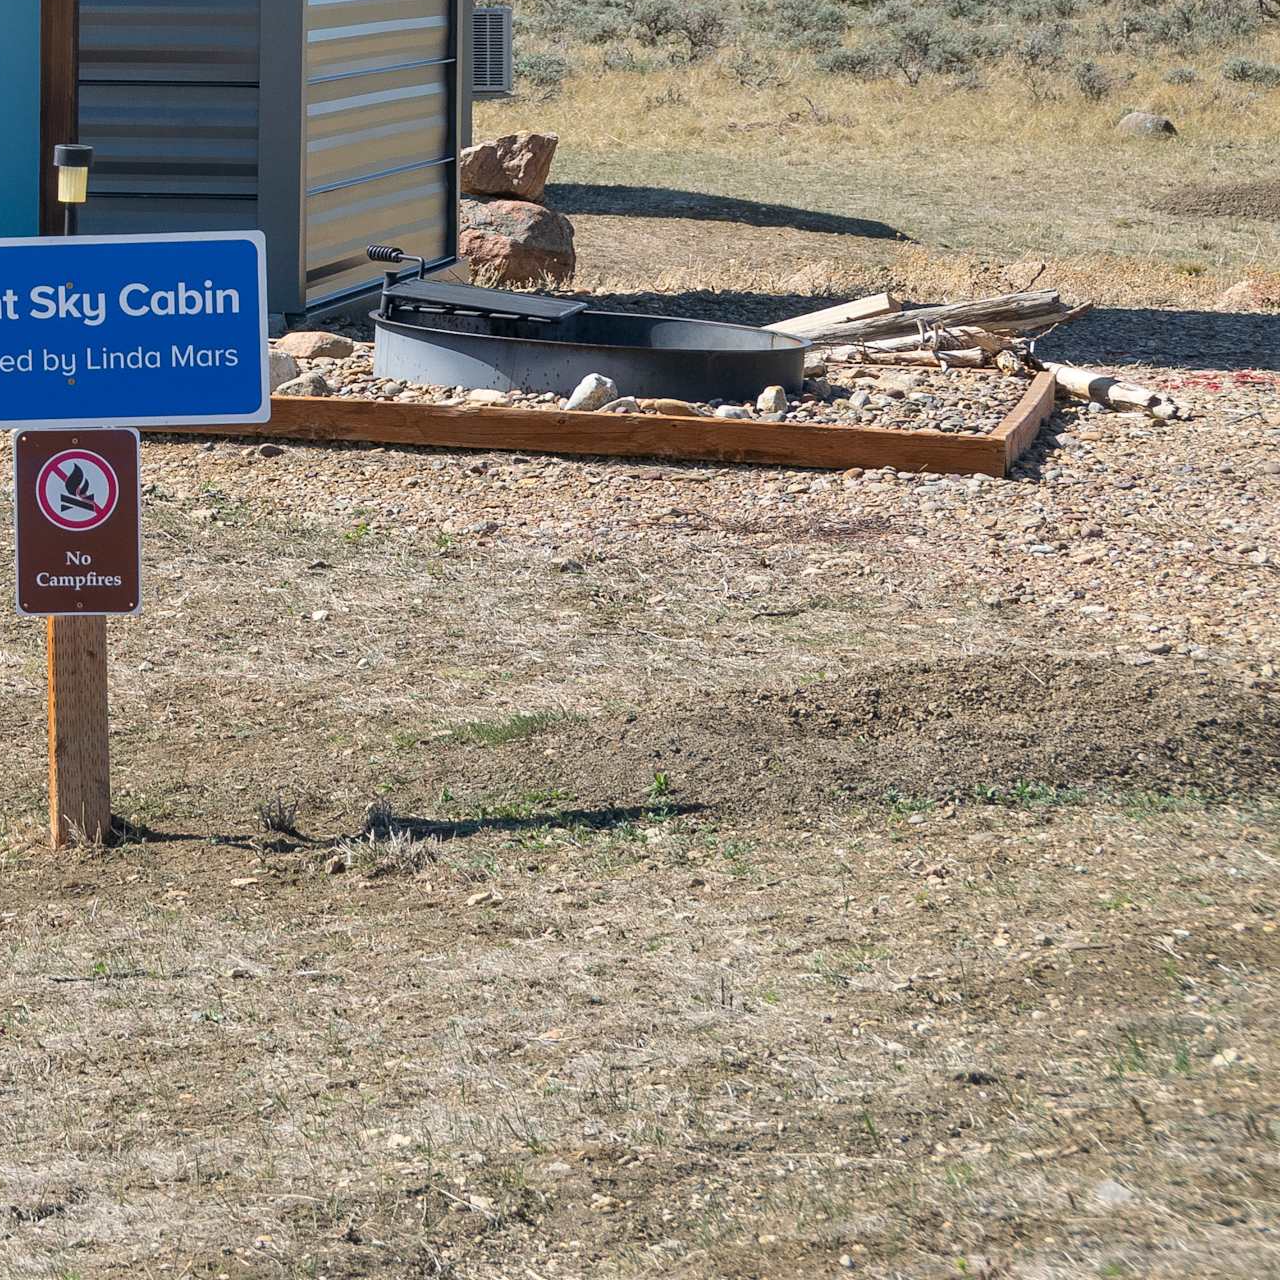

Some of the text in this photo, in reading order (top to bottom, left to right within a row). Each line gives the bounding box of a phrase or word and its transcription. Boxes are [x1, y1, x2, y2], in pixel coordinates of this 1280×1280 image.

[30, 283, 105, 325] Sky
[119, 279, 239, 317] Cabin
[43, 348, 76, 376] by
[86, 346, 160, 370] Linda
[171, 344, 238, 368] Mars
[65, 550, 91, 566] No
[36, 571, 122, 590] Campfires
